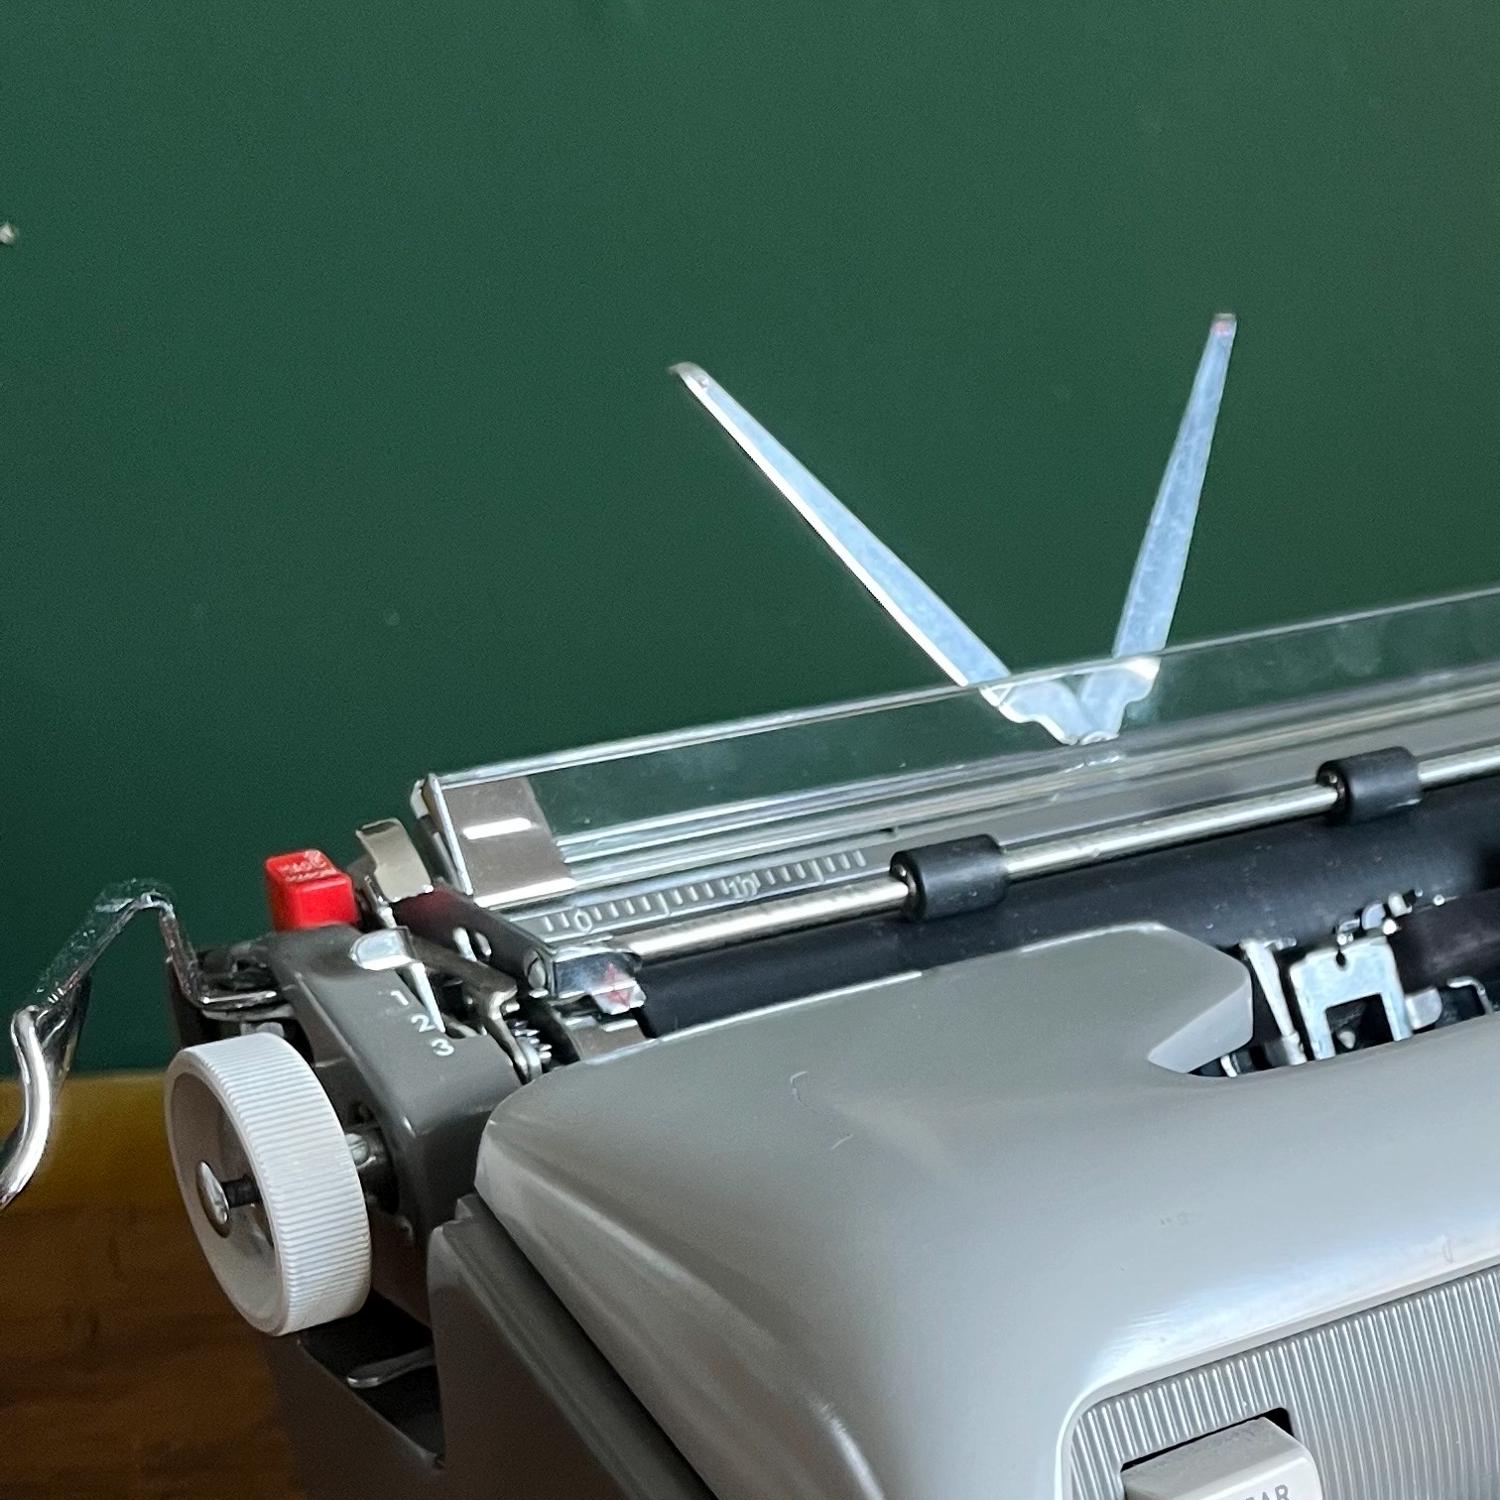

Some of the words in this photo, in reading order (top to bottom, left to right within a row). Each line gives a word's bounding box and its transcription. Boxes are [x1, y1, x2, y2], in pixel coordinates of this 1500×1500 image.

[390, 990, 409, 1006] 1
[410, 1014, 437, 1033] 2
[431, 1038, 455, 1057] 3
